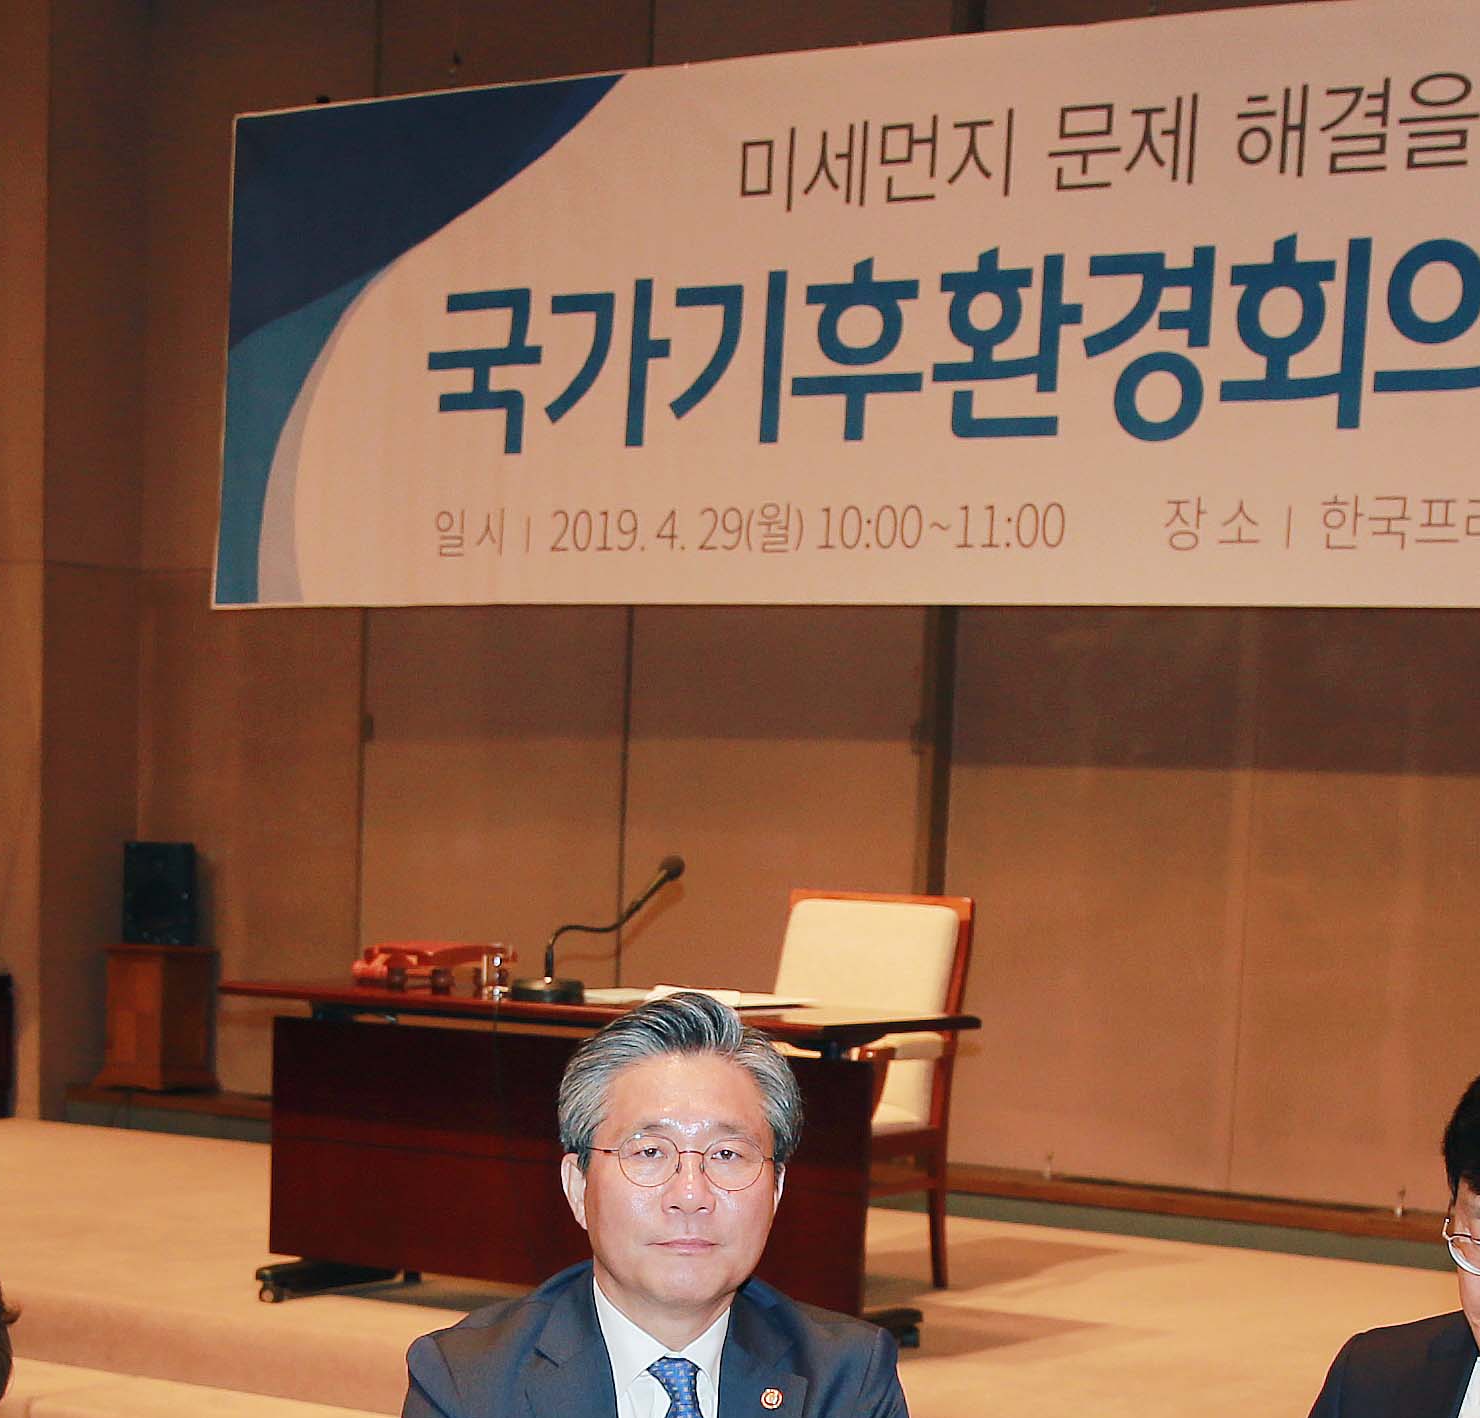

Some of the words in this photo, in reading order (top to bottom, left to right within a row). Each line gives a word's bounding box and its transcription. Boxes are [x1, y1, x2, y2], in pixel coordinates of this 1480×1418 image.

[739, 106, 1015, 214] 미세먼지
[1046, 91, 1200, 193] 문제
[816, 500, 1067, 551] 10:00~11:00
